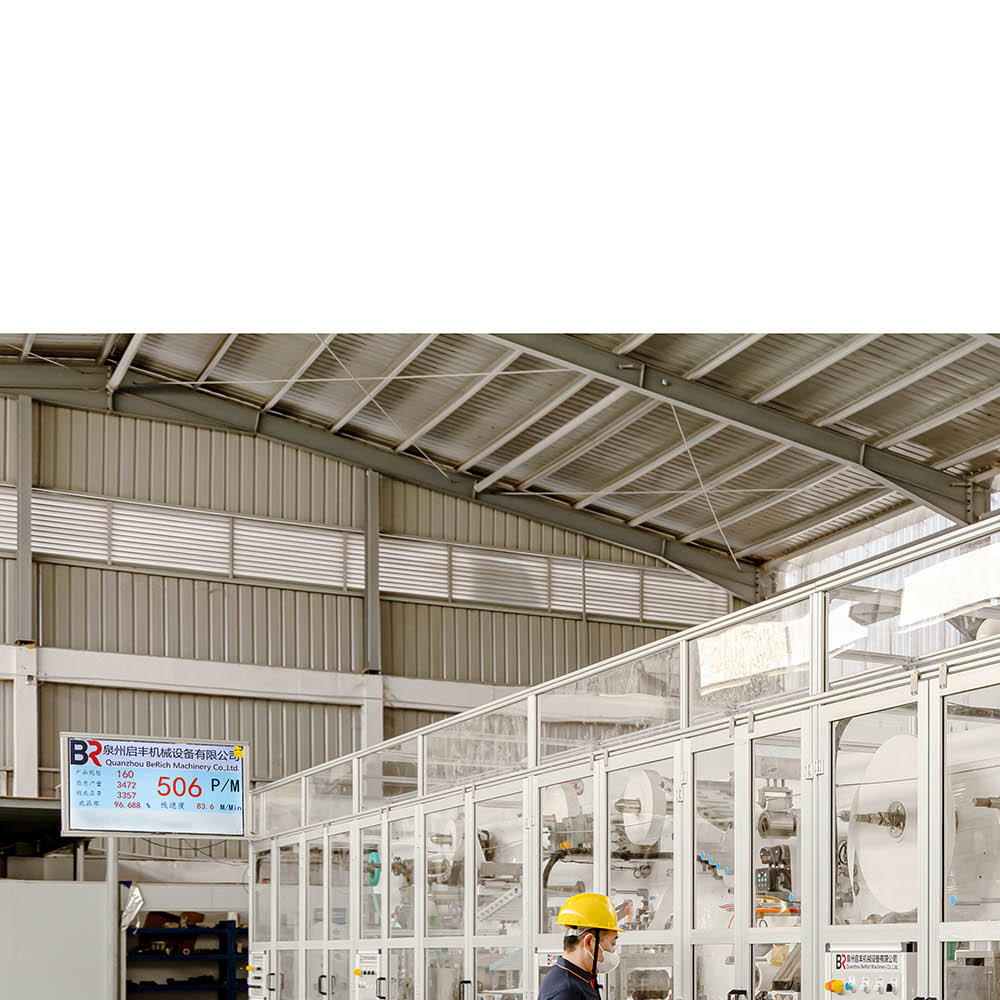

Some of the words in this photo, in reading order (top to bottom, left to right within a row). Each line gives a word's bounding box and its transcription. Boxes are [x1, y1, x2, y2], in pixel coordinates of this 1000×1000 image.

[102, 744, 240, 762] 泉州启丰机械设备有限公司
[105, 759, 144, 768] Quanzhou
[146, 761, 171, 769] BeRich
[173, 762, 211, 772] Machinery
[117, 770, 134, 779] 160
[117, 781, 137, 789] 3472
[157, 776, 202, 798] 506
[211, 778, 240, 793] P/M
[117, 791, 137, 799] 3357
